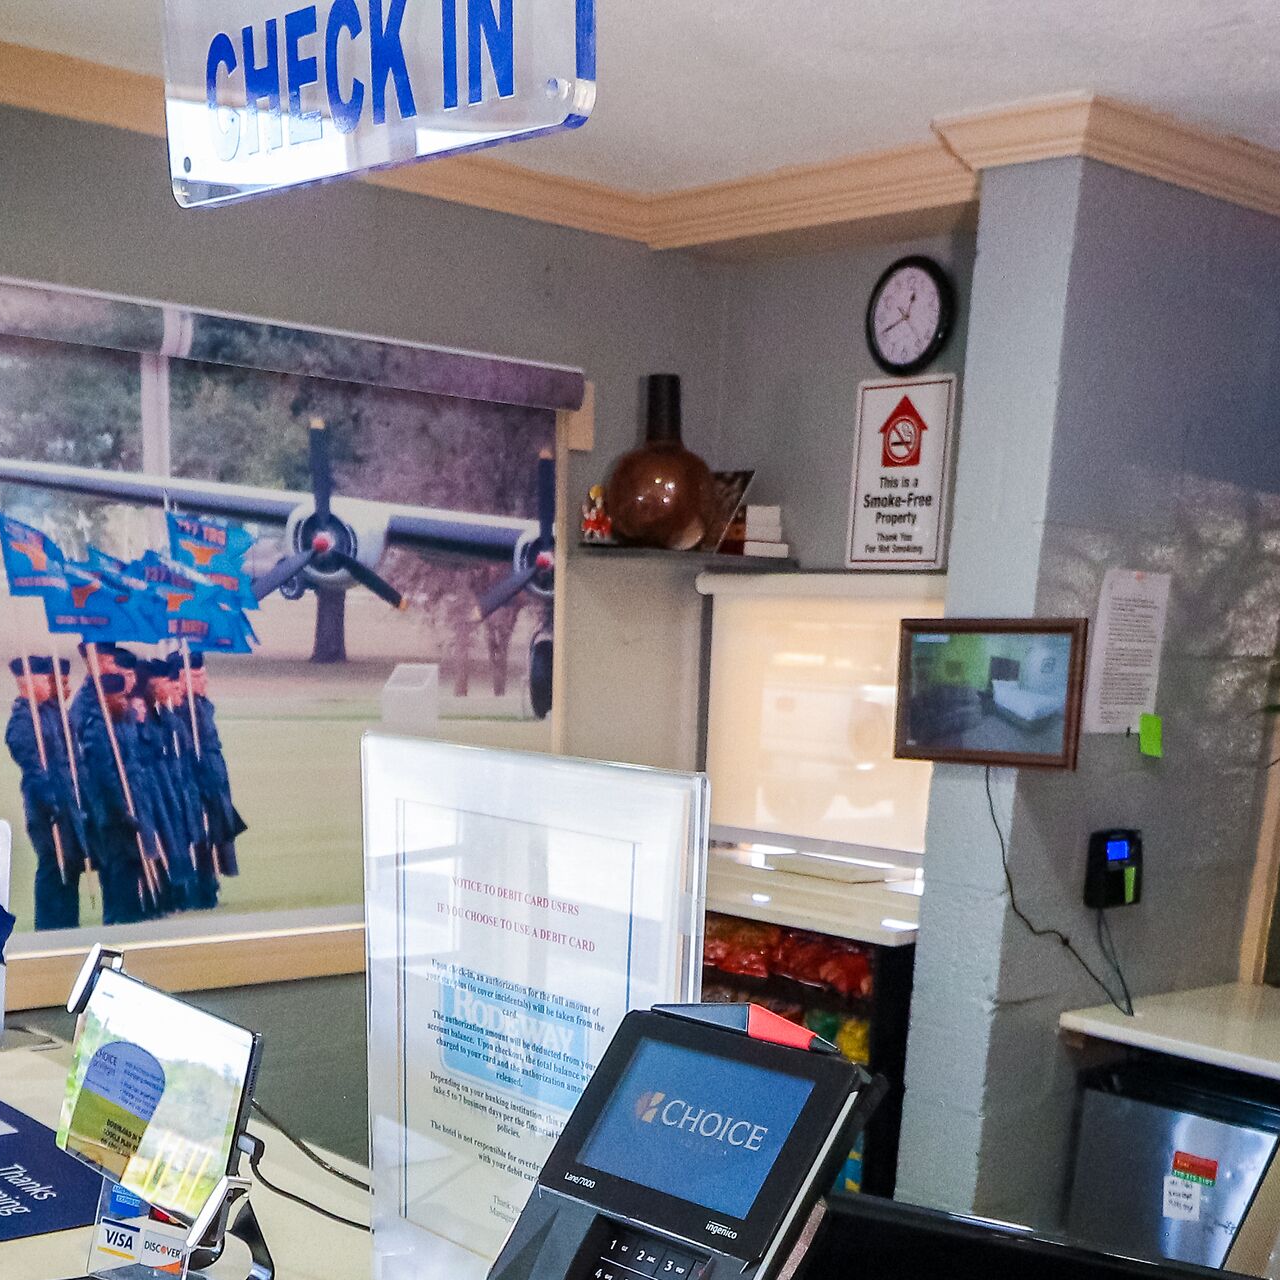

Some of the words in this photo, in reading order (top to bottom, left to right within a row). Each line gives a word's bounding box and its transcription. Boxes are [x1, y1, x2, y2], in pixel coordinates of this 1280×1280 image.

[206, 0, 417, 161] CHECK
[442, 0, 515, 111] IN
[863, 492, 932, 508] Smoke-Free
[880, 476, 898, 488] This
[901, 476, 910, 488] is
[913, 478, 918, 488] a
[876, 511, 917, 526] Property
[452, 876, 482, 893] NOTICE
[483, 883, 496, 896] TO
[497, 887, 523, 902] DEBIT
[524, 894, 549, 909] CARD
[551, 900, 579, 917] USERS
[437, 902, 445, 913] IF
[445, 905, 464, 918] YOU
[465, 909, 499, 928] CHOOSE
[500, 918, 512, 931] TO
[514, 922, 530, 936] USE
[531, 927, 538, 938] A
[540, 928, 567, 945] DEBIT
[568, 936, 596, 952] CARD
[477, 987, 494, 998] cover
[532, 1003, 545, 1014] will
[546, 1006, 555, 1017] be
[556, 1010, 575, 1024] taken
[576, 1015, 593, 1029] from
[594, 1021, 606, 1033] the
[485, 975, 527, 996] authorization
[528, 987, 538, 998] for
[539, 989, 551, 1001] the
[551, 992, 564, 1005] full
[565, 1000, 592, 1015] amount
[592, 1007, 600, 1016] of
[427, 1023, 450, 1037] account
[477, 1037, 494, 1052] Upon
[525, 1054, 536, 1065] the
[536, 1057, 553, 1071] total
[553, 1063, 579, 1081] balance
[432, 1009, 445, 1020] The
[445, 1014, 484, 1035] authorization
[485, 1027, 509, 1042] amount
[509, 1035, 522, 1047] will
[522, 1039, 531, 1050] be
[531, 1043, 562, 1061] deducted
[563, 1052, 579, 1065] from
[436, 1037, 460, 1054] charged
[460, 1045, 466, 1054] to
[466, 1047, 482, 1061] your
[482, 1053, 496, 1066] card
[497, 1059, 510, 1070] and
[510, 1062, 521, 1073] the
[521, 1067, 565, 1089] authorization
[430, 1071, 461, 1091] Depending
[461, 1085, 469, 1093] on
[469, 1087, 485, 1099] your
[485, 1092, 509, 1109] banking
[433, 1085, 446, 1096] take
[446, 1089, 451, 1097] 5
[451, 1092, 458, 1100] to
[463, 1095, 488, 1113] business
[488, 1105, 503, 1119] days
[503, 1113, 514, 1124] per
[514, 1116, 525, 1127] the
[431, 1119, 441, 1131] The
[442, 1124, 457, 1137] hotel
[457, 1131, 463, 1140] is
[463, 1134, 473, 1144] not
[474, 1139, 507, 1158] responsible
[507, 1151, 517, 1162] for
[661, 1099, 768, 1151] CHOICE
[478, 1152, 491, 1164] with
[491, 1157, 507, 1170] your
[507, 1163, 522, 1178] debit
[565, 1171, 596, 1189] Lane/7000
[493, 1194, 510, 1209] Thank
[105, 1228, 134, 1250] VISA
[144, 1240, 182, 1260] DISCOVER
[705, 1221, 738, 1240] ingenico
[594, 1268, 603, 1279] 4
[610, 1239, 617, 1250] 1
[636, 1250, 646, 1261] 2
[664, 1260, 674, 1271] 3
